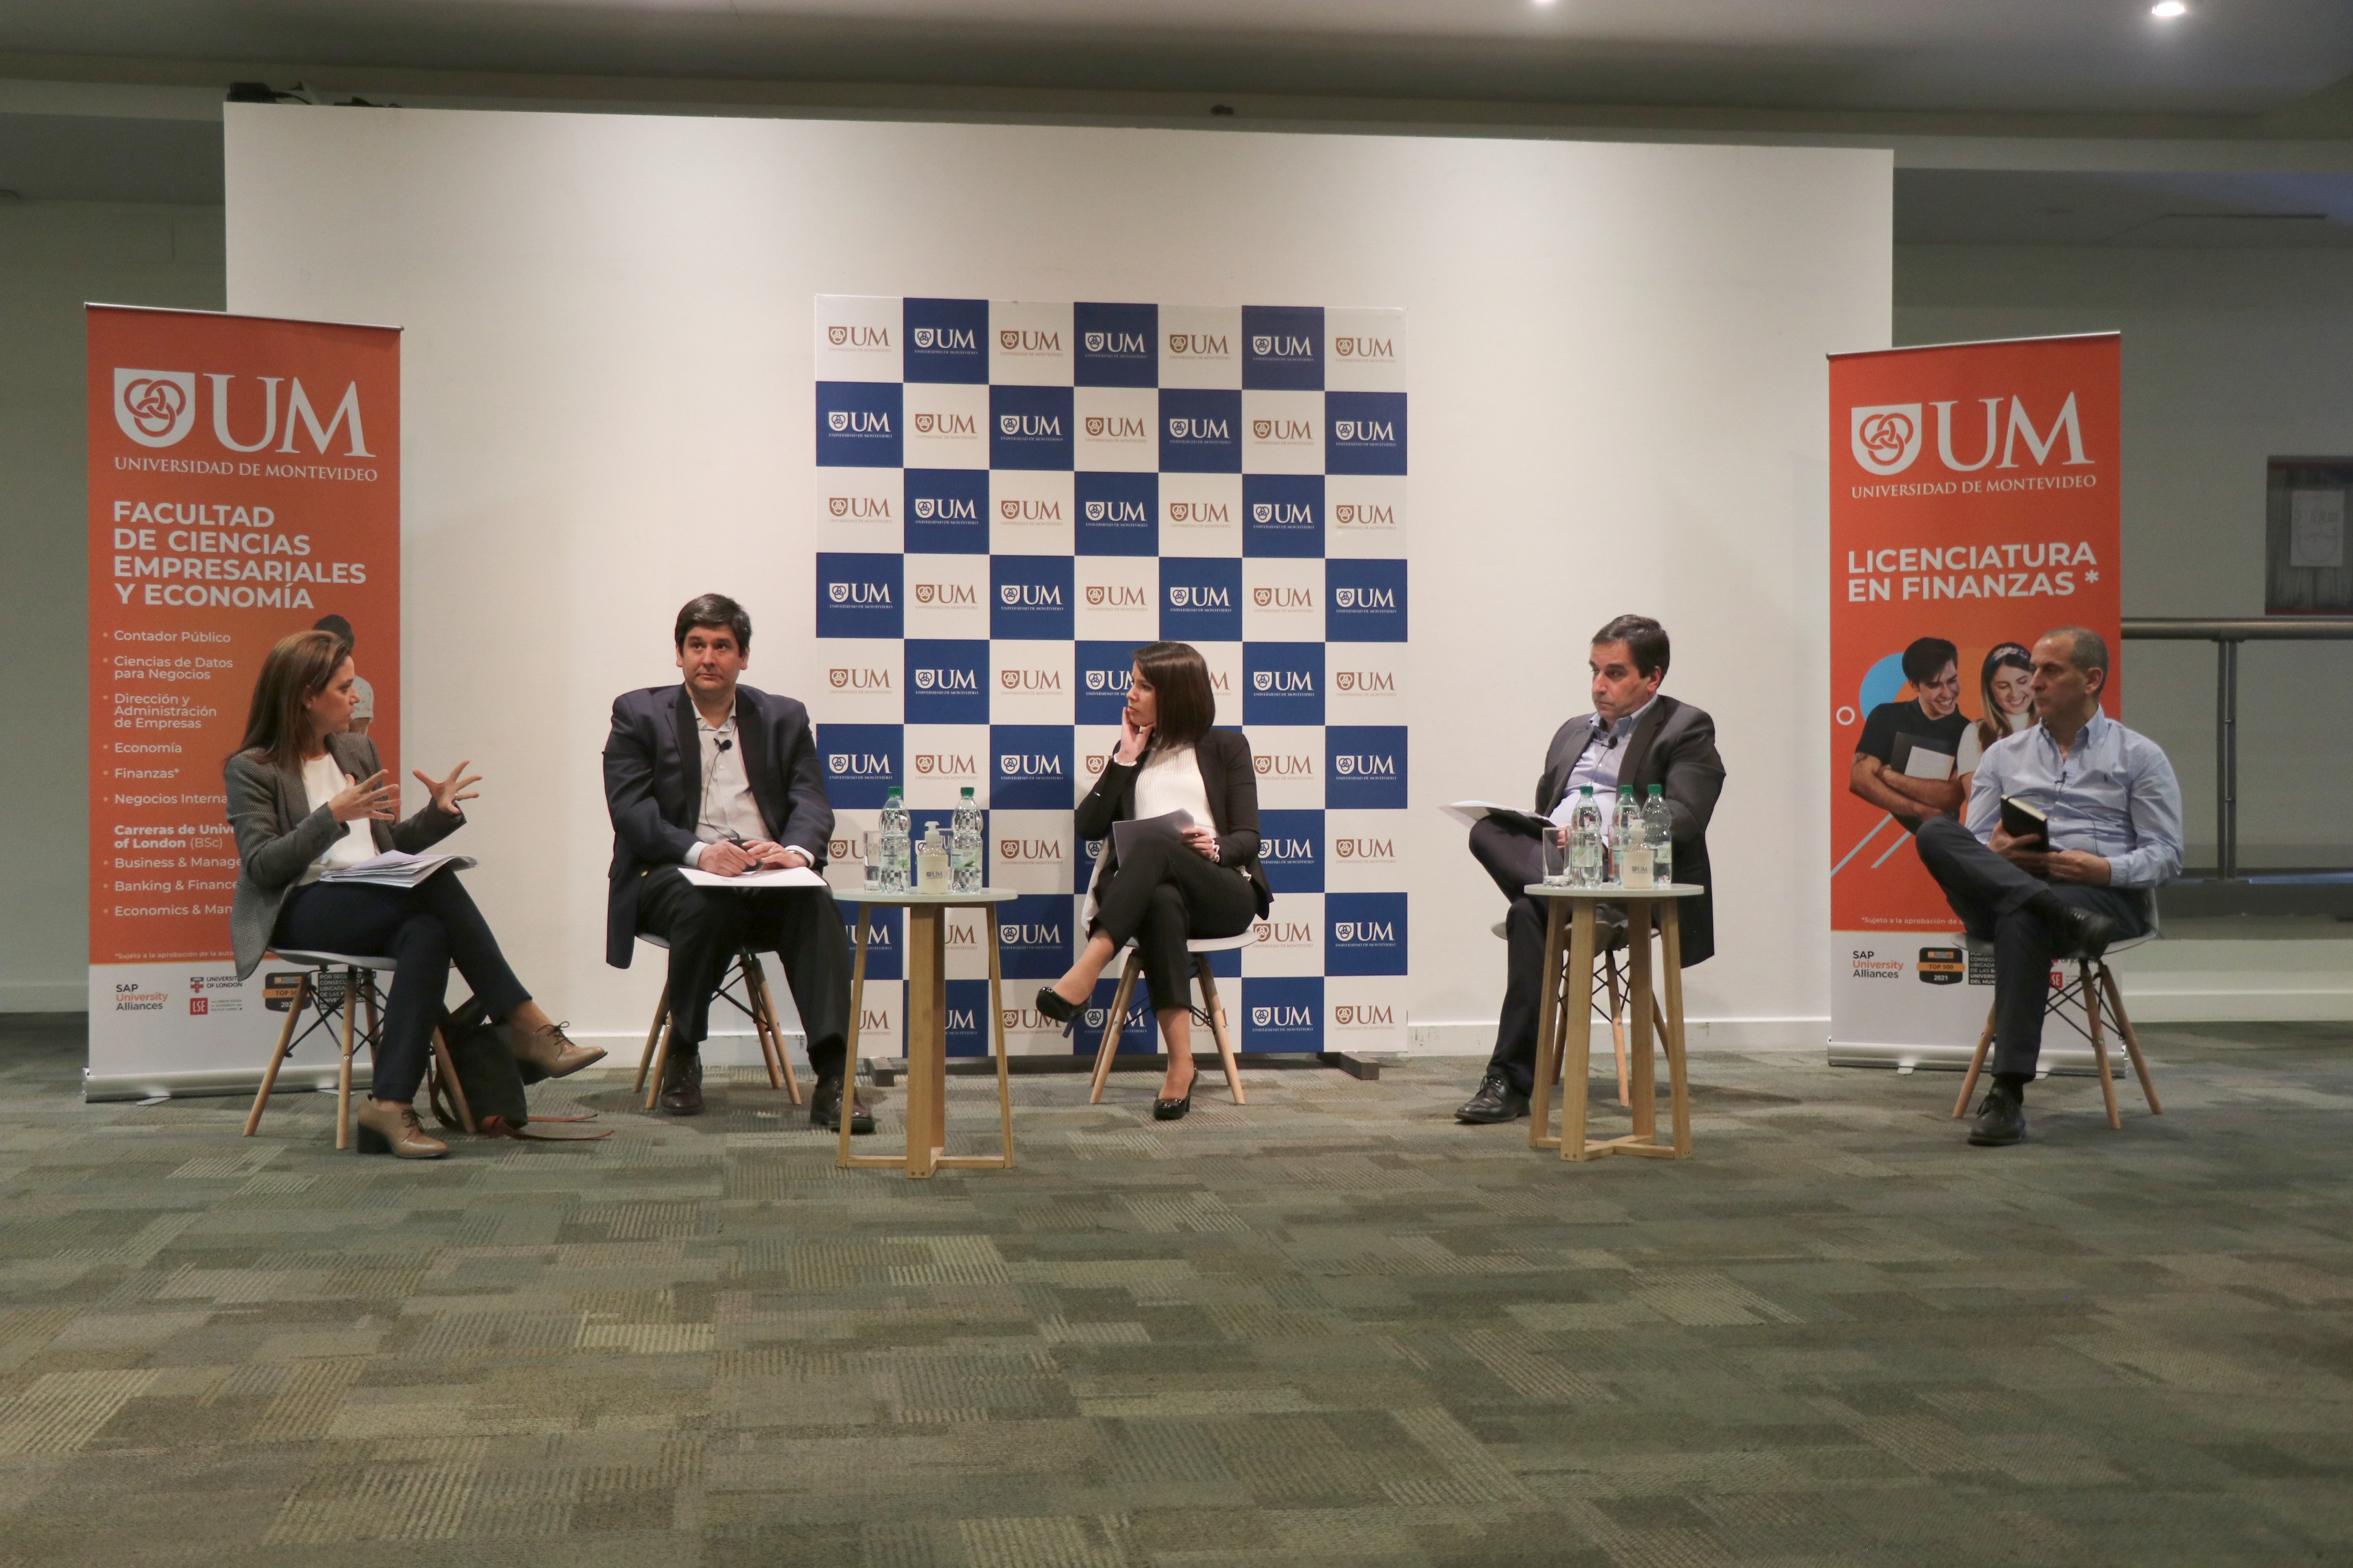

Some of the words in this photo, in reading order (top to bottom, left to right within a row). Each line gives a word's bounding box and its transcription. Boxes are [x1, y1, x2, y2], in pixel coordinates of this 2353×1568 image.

[850, 327, 891, 346] UM
[936, 329, 977, 348] UM
[1022, 331, 1062, 350] UM
[1106, 333, 1147, 352] UM
[1191, 335, 1230, 353] UM
[1274, 337, 1312, 355] UM
[1356, 338, 1394, 356] UM
[203, 373, 376, 457] UM
[850, 413, 891, 432] UM
[936, 415, 977, 433] UM
[1022, 416, 1062, 435] UM
[1106, 418, 1147, 436] UM
[1191, 419, 1230, 438] UM
[1274, 421, 1312, 439] UM
[1356, 422, 1394, 440] UM
[1929, 391, 2095, 471] UM
[115, 457, 233, 475] UNIVERSIDAD
[239, 463, 261, 476] DE
[266, 464, 378, 482] MONTEVIDEO
[1852, 482, 1957, 498] UNIVERSIDAD
[1962, 482, 1982, 493] DE
[1986, 475, 2096, 491] MONTEVIDEO
[115, 501, 275, 527] FACULTAD
[850, 498, 891, 517] UM
[936, 499, 977, 518] UM
[1022, 501, 1062, 519] UM
[1106, 502, 1147, 521] UM
[1191, 503, 1230, 522] UM
[1274, 505, 1312, 523] UM
[1356, 506, 1394, 524] UM
[115, 528, 157, 550] DE
[168, 531, 311, 555] CIENCIAS
[1848, 542, 2097, 574] LICENCIATURA
[115, 556, 367, 584] EMPRESARIALES
[115, 583, 135, 604] Y
[145, 582, 314, 609] ECONOMÍA
[850, 583, 891, 602] UM
[936, 585, 977, 603] UM
[1022, 586, 1062, 604] UM
[1849, 578, 1890, 602] EN
[1902, 571, 2075, 600] FINANZAS
[1106, 587, 1147, 605] UM
[1191, 587, 1230, 606] UM
[1274, 589, 1312, 606] UM
[1356, 589, 1394, 607] UM
[115, 630, 178, 642] Contador
[182, 631, 231, 642] Público
[115, 655, 171, 667] Ciencias
[174, 657, 191, 667] de
[195, 657, 233, 668] Datos
[115, 670, 144, 680] para
[149, 669, 211, 681] Negocios
[850, 669, 891, 688] UM
[936, 670, 977, 688] UM
[1022, 671, 1062, 689] UM
[1274, 672, 1312, 690] UM
[1356, 673, 1394, 690] UM
[115, 693, 178, 704] Dirección
[182, 696, 190, 707] y
[114, 705, 216, 716] Administración
[115, 718, 132, 728] de
[136, 718, 202, 730] Empresas
[115, 742, 182, 753] Economía
[850, 754, 891, 773] UM
[936, 755, 977, 773] UM
[1022, 755, 1062, 774] UM
[1274, 756, 1312, 774] UM
[1356, 756, 1394, 774] UM
[115, 793, 178, 806] Negocios
[114, 825, 174, 835] Carreras
[178, 823, 196, 834] de
[114, 838, 130, 849] of
[133, 838, 186, 849] London
[191, 837, 223, 850] (BSc)
[1022, 840, 1062, 859] UM
[1274, 840, 1312, 858] UM
[1356, 840, 1394, 857] UM
[115, 857, 174, 868] Business
[178, 857, 187, 867] &
[115, 880, 172, 892] Banking
[175, 880, 184, 890] &
[115, 905, 189, 917] Economics
[192, 905, 201, 915] &
[1022, 925, 1062, 943] UM
[1274, 924, 1312, 941] UM
[1356, 922, 1394, 941] UM
[1853, 951, 1874, 959] SAP
[1853, 960, 1903, 971] University
[1853, 969, 1898, 978] Alliances
[116, 984, 138, 992] SAP
[116, 992, 168, 1002] University
[116, 1002, 163, 1011] Alliances
[193, 1001, 205, 1012] LSE
[1274, 1006, 1312, 1025] UM
[1356, 1006, 1394, 1024] UM
